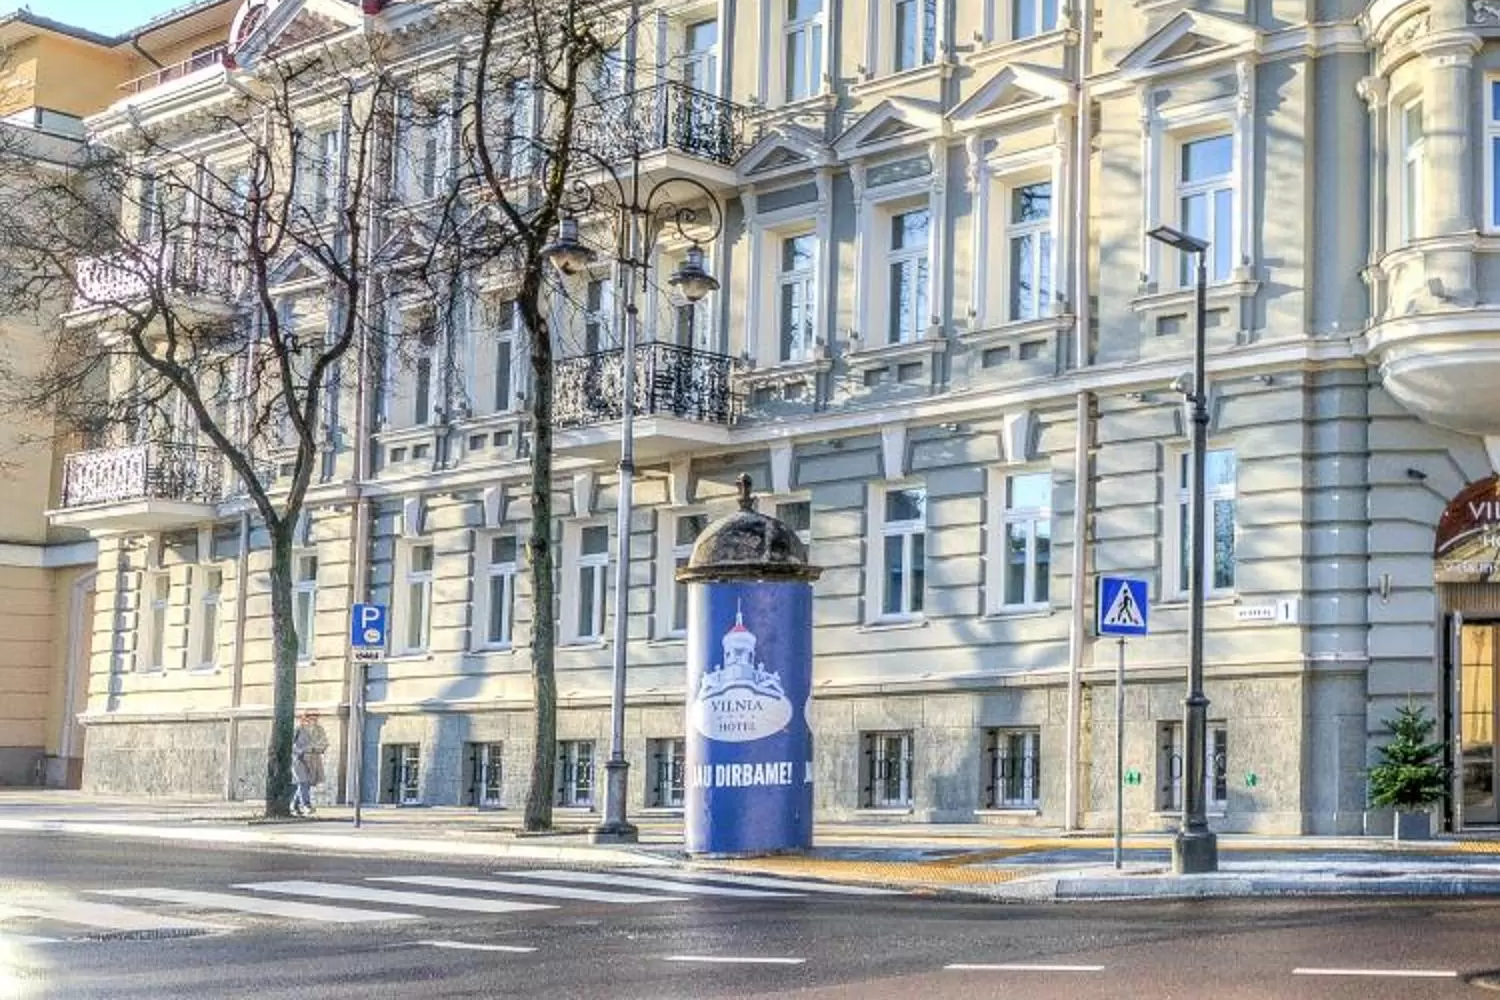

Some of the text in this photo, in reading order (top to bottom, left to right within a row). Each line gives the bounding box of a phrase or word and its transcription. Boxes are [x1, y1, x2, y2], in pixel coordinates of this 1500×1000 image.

[361, 607, 380, 628] P
[711, 700, 764, 712] VILNIA
[715, 761, 793, 787] DIRBAME!
